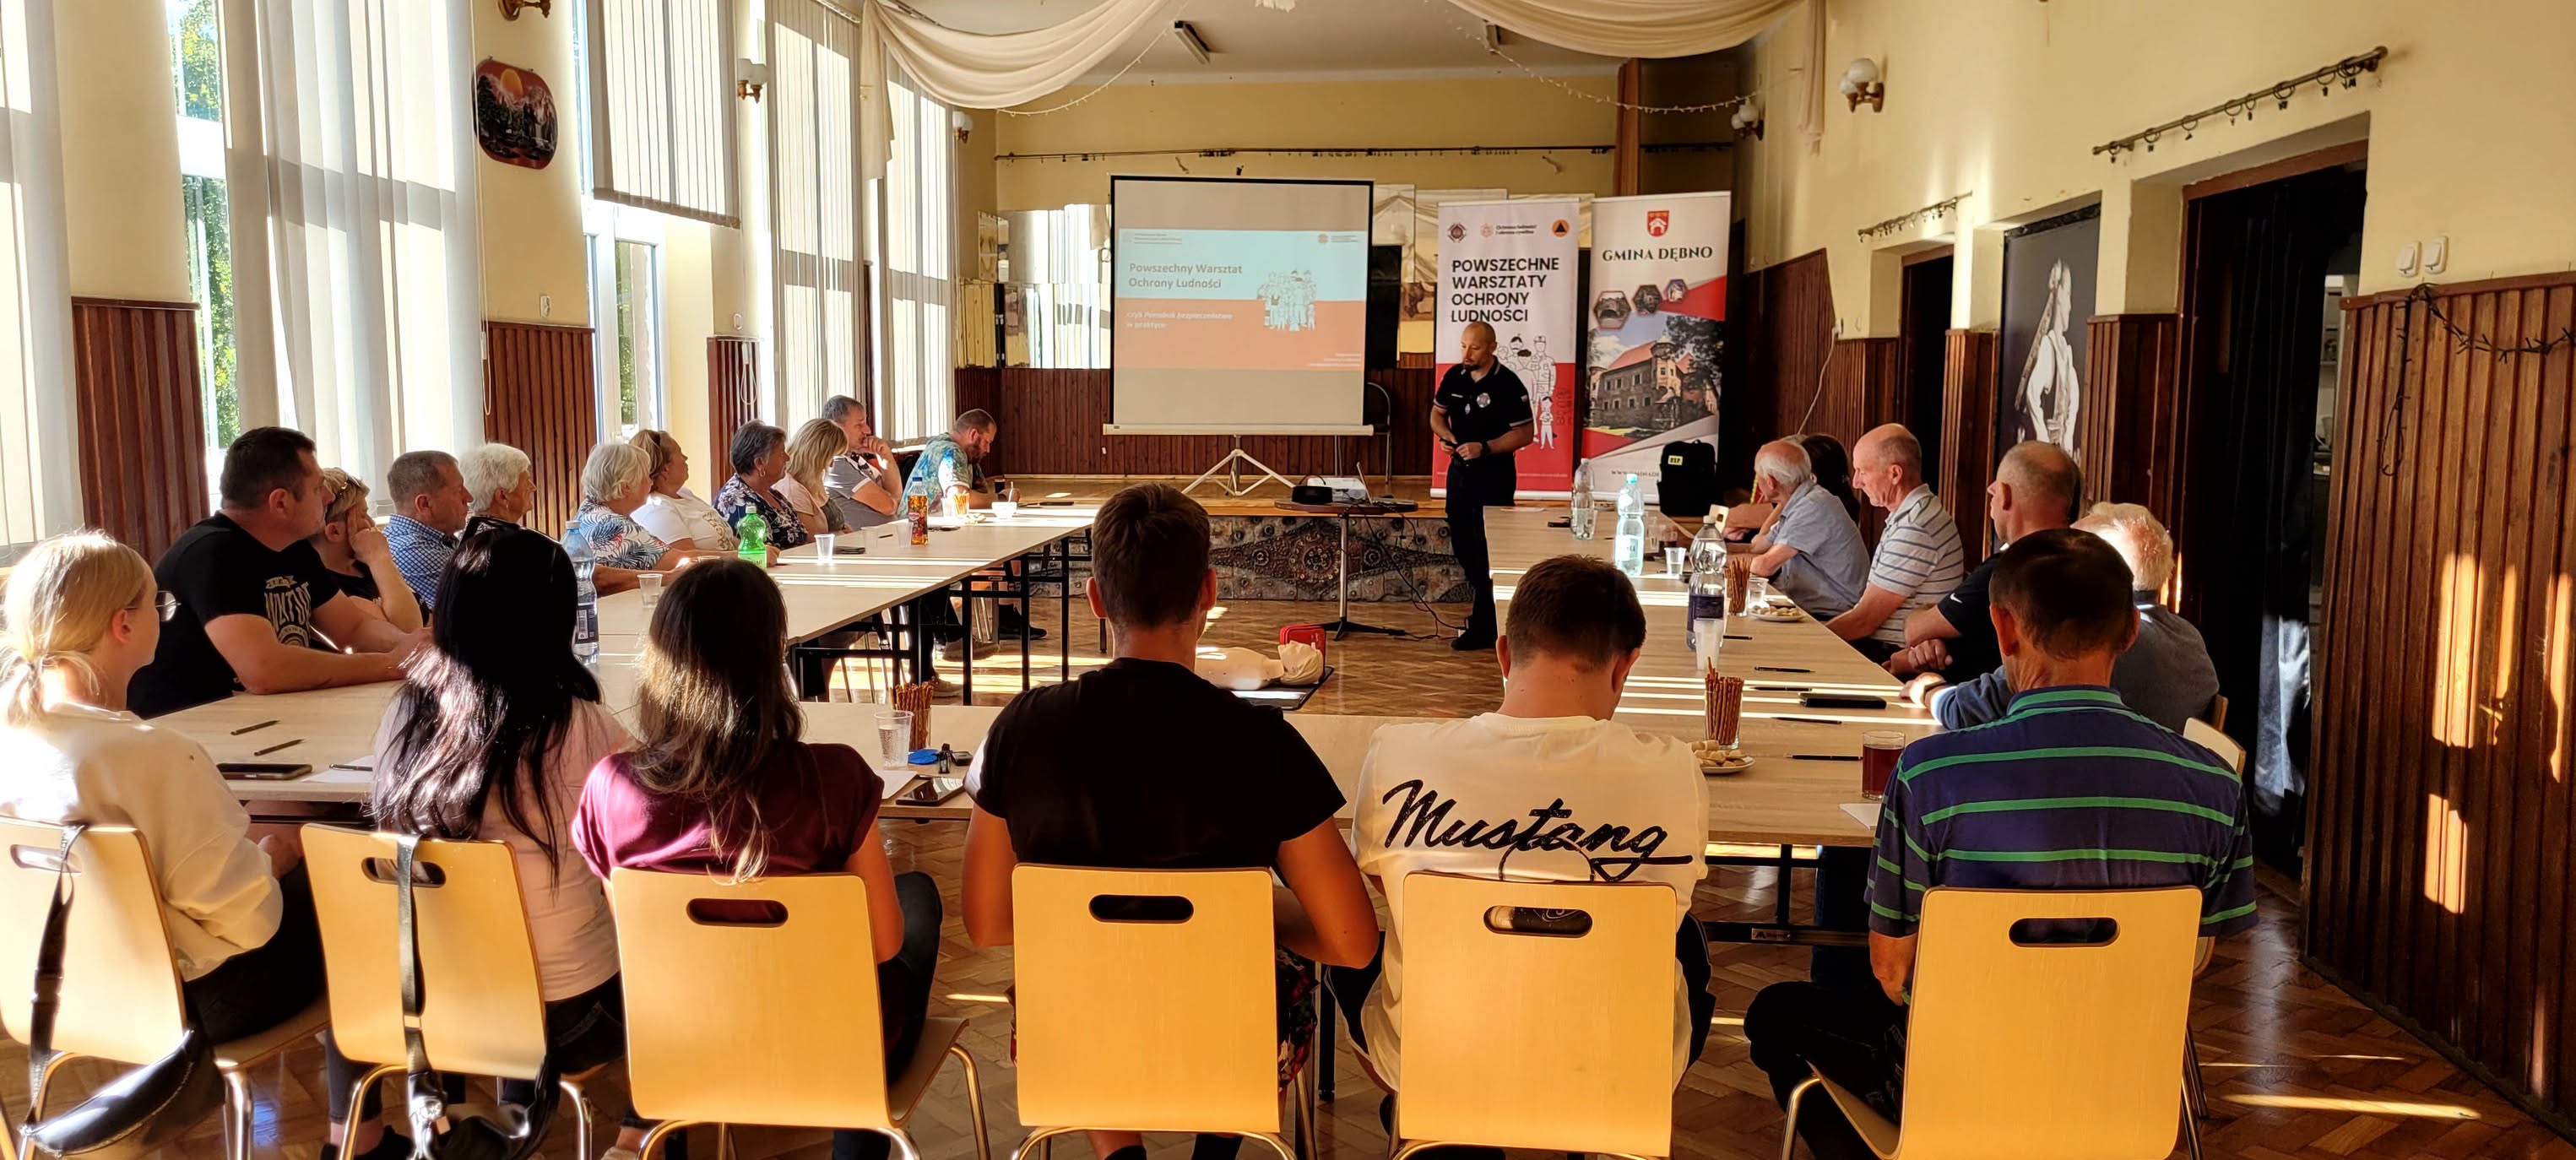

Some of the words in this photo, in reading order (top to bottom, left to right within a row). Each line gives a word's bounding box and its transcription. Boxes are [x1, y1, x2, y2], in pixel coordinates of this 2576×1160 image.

[1602, 249, 1654, 262] GMINA
[1658, 247, 1713, 263] DĘBNO
[1129, 263, 1193, 275] Powszechny
[1196, 263, 1243, 274] Warsztat
[1451, 257, 1559, 273] POWSZECHNE
[1128, 277, 1174, 290] Ochrony
[1176, 278, 1222, 289] Ludności
[1452, 274, 1547, 289] WARSZTATY
[1451, 292, 1529, 306] OCHRONY
[1451, 305, 1528, 323] LUDNOŚCI
[1382, 778, 1693, 882] Mustang
